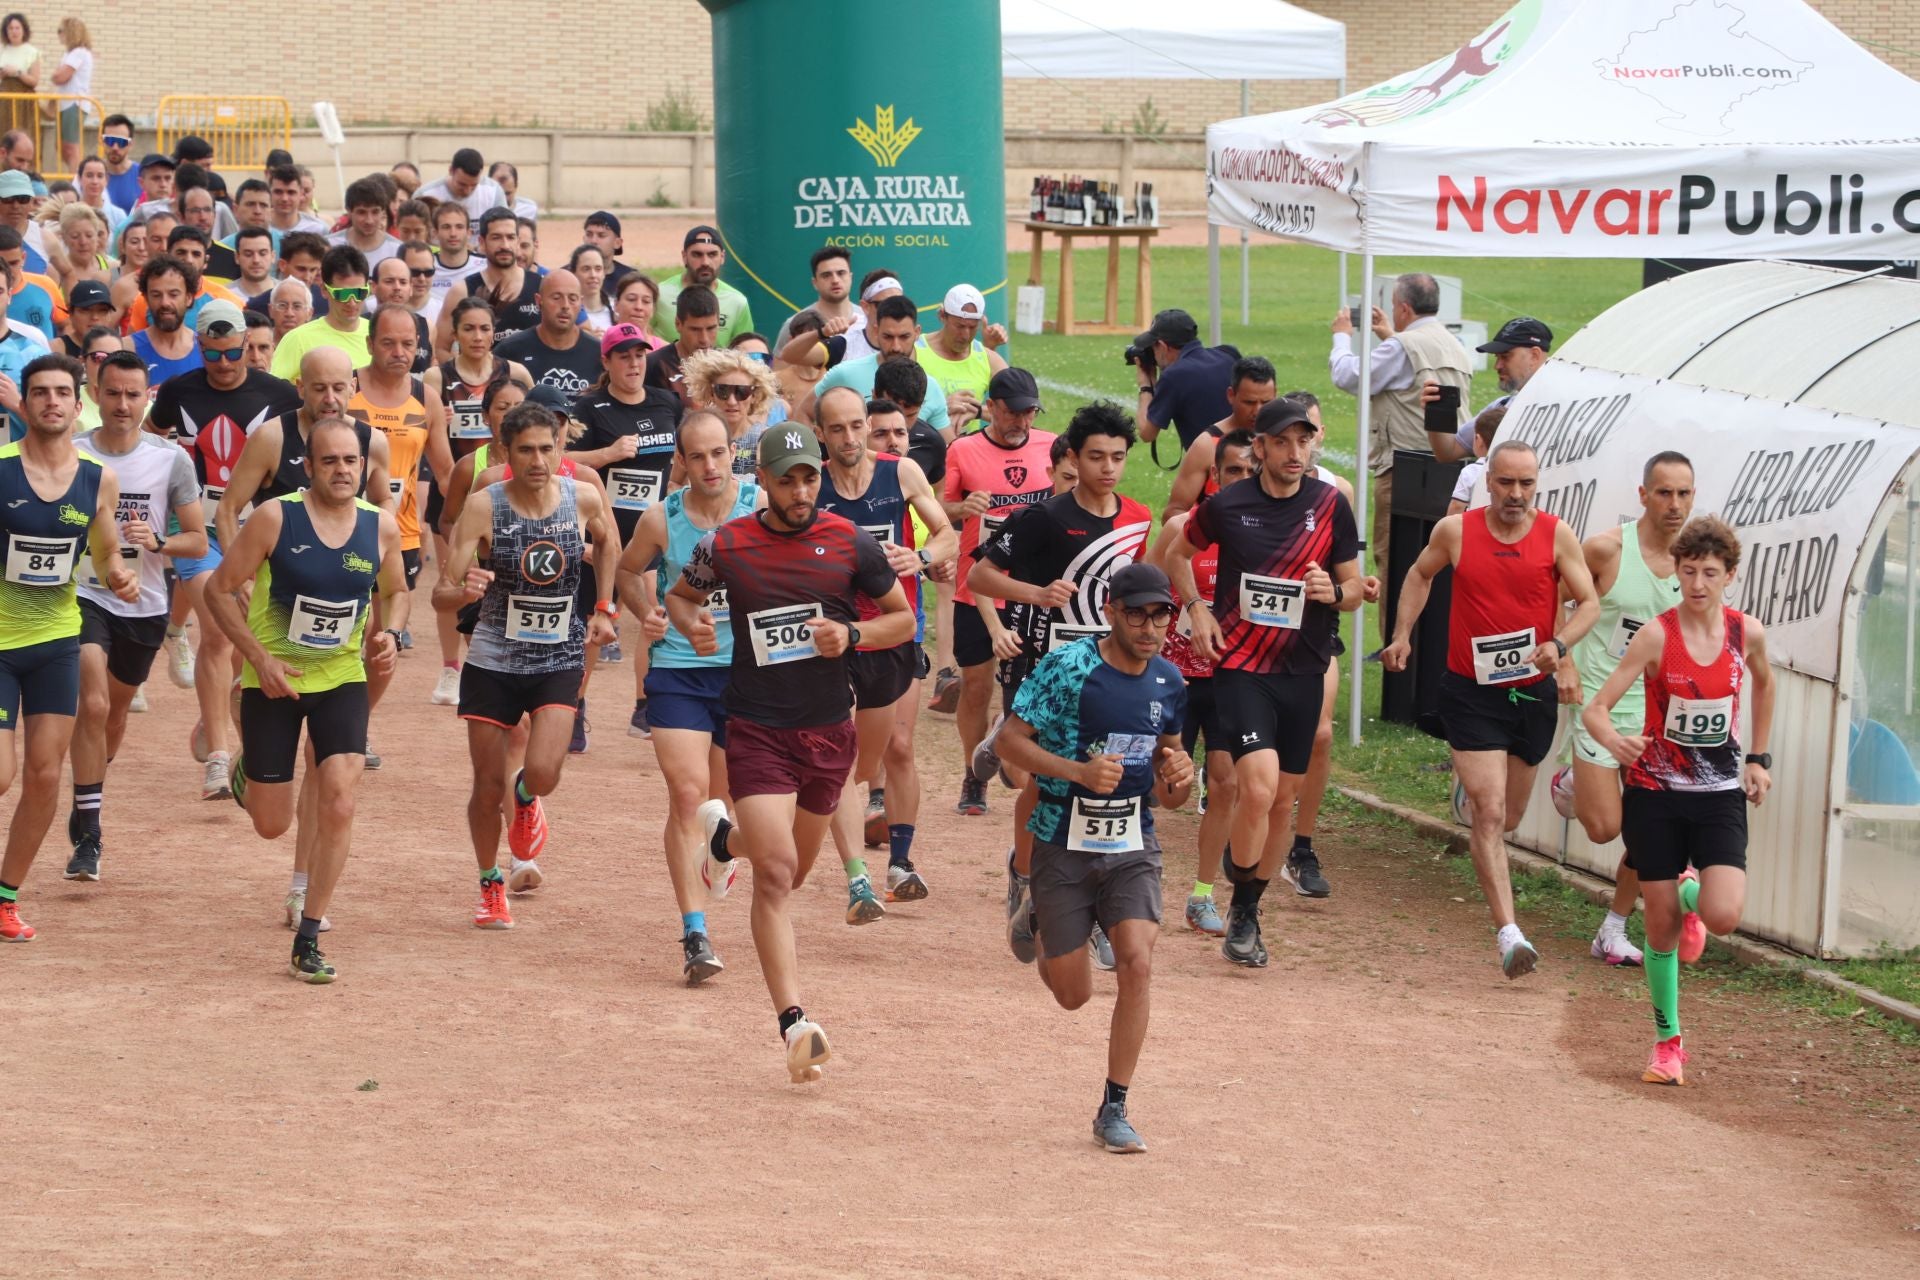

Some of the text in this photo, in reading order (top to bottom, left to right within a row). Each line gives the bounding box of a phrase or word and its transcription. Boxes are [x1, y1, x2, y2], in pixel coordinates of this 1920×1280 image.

[1614, 65, 1792, 79] NavarPubli.com
[1220, 147, 1290, 183] COMUNICADOR
[799, 175, 965, 204] CAJA RURAL
[794, 203, 972, 228] DE NAVARRA
[825, 233, 949, 247] ACCIÓN SOCIAL
[617, 483, 651, 498] 529
[543, 522, 574, 535] K-TEAM
[28, 555, 56, 570] 84
[1250, 592, 1290, 612] 541
[312, 617, 339, 634] 54
[520, 612, 561, 629] 519
[765, 623, 811, 648] 506
[1493, 650, 1521, 668] 60
[1674, 713, 1727, 734] 199
[1085, 819, 1128, 837] 513
